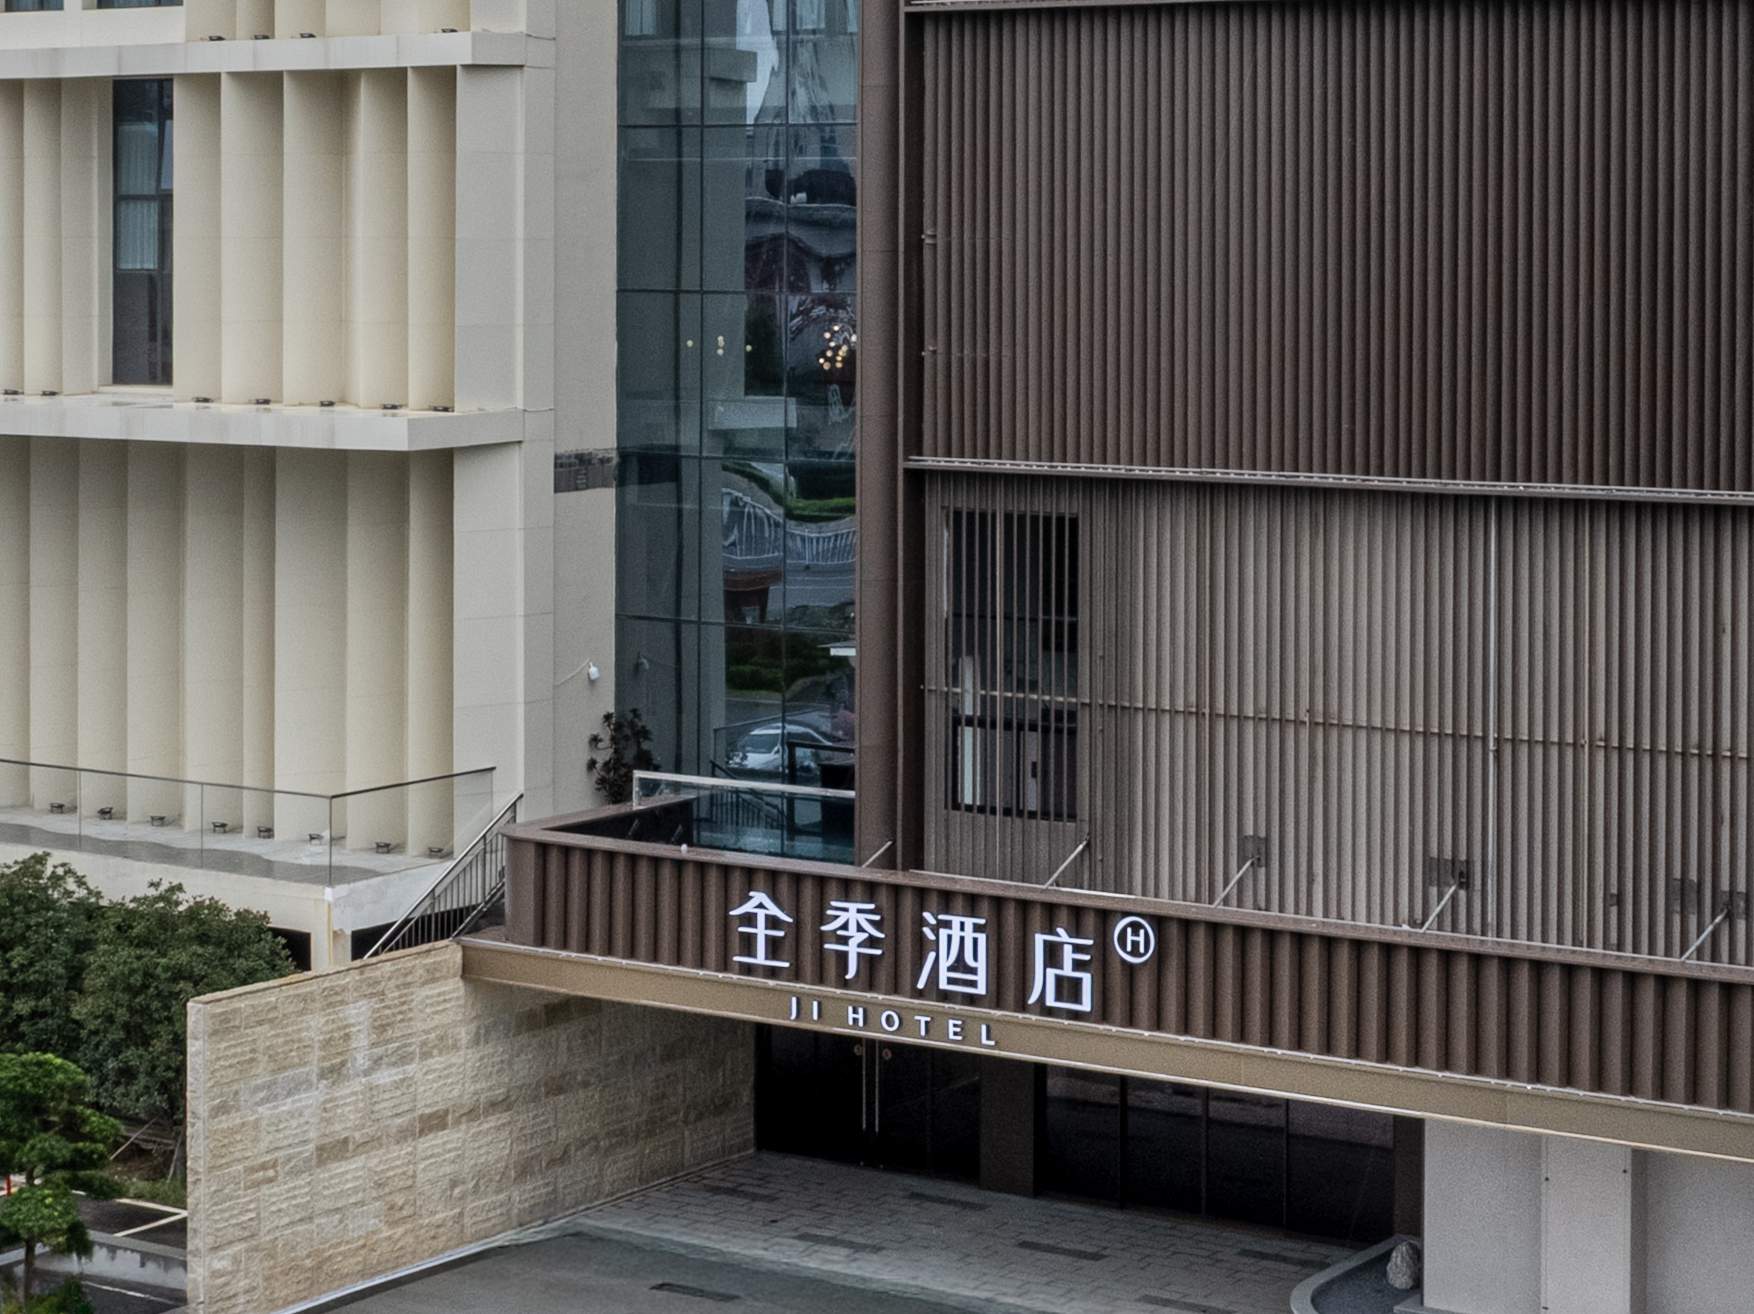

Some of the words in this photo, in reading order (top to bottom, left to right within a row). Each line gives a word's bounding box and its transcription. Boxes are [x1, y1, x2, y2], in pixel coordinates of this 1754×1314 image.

[728, 890, 1095, 1013] 全季酒店
[789, 995, 819, 1022] JI
[846, 1004, 997, 1047] HOTEL
